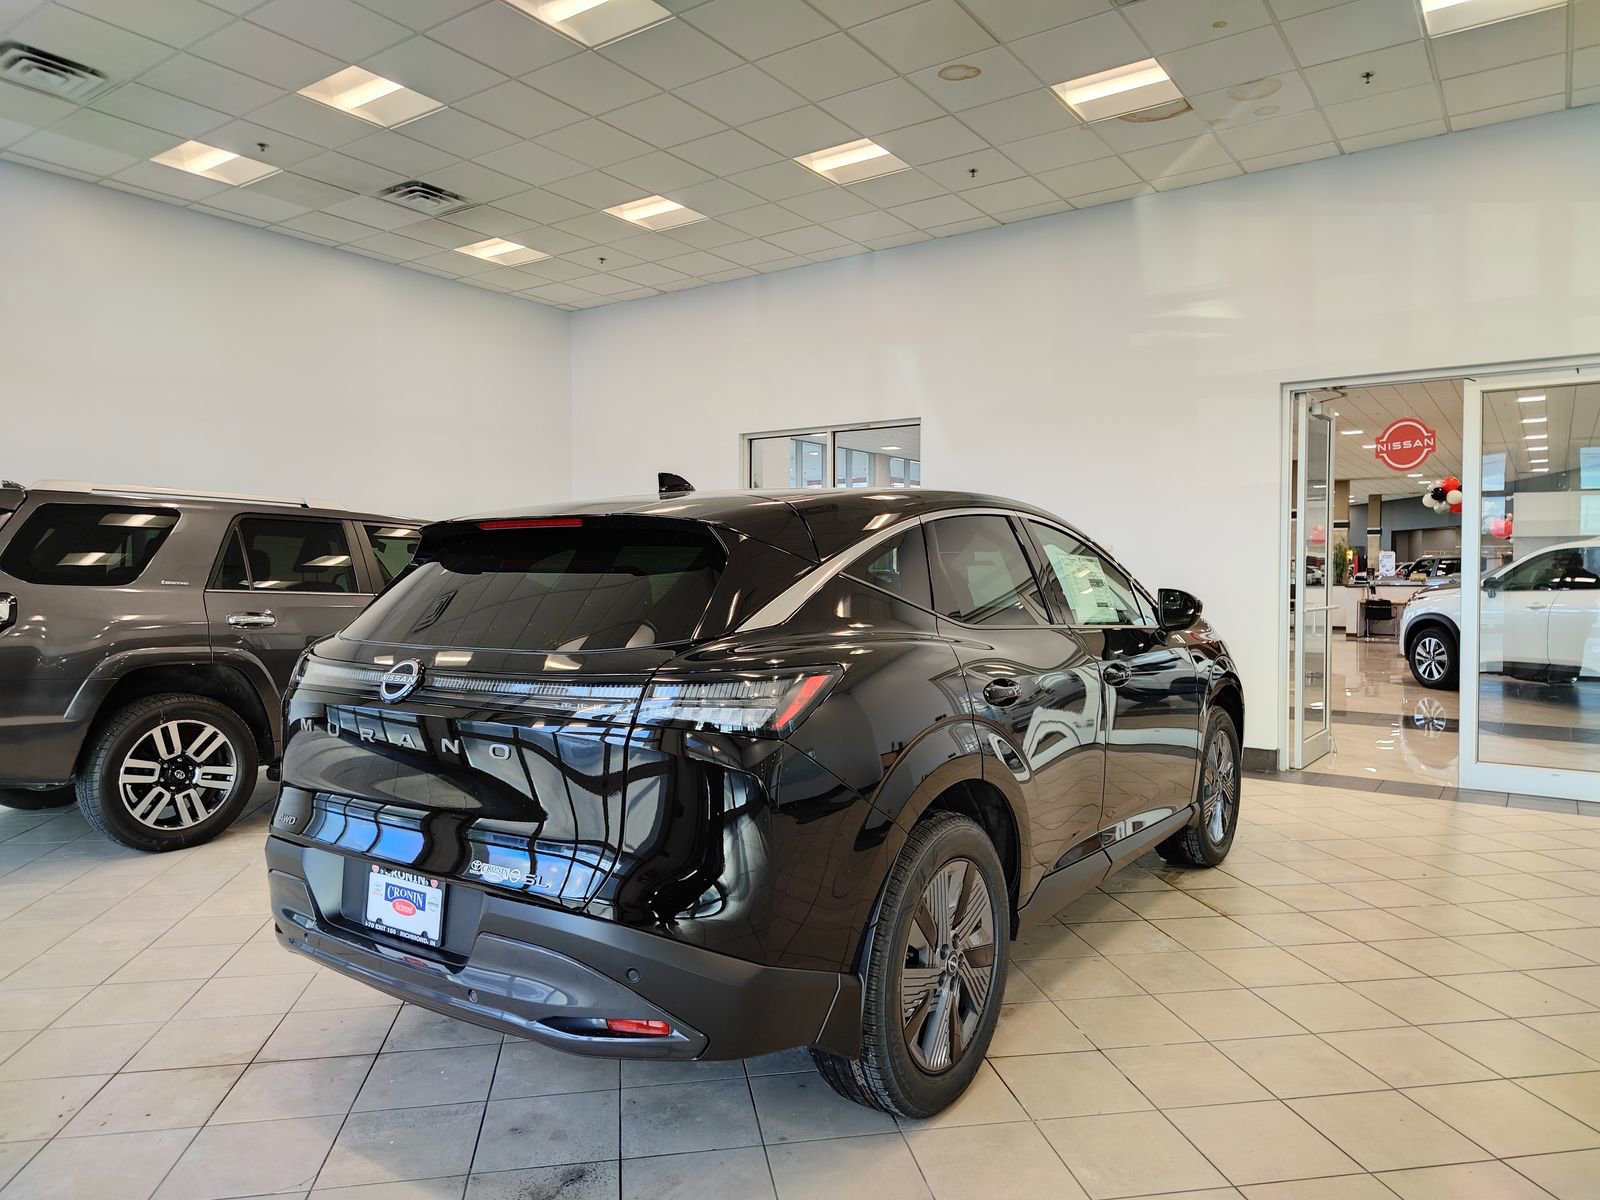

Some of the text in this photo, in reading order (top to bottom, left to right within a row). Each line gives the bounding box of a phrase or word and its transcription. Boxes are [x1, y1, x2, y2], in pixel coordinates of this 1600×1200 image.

[1377, 437, 1434, 452] NISSAN
[381, 673, 418, 685] NISSAN
[300, 717, 512, 762] MURANO
[279, 813, 297, 825] AWD
[523, 873, 553, 889] SL
[387, 885, 424, 909] CRONIN
